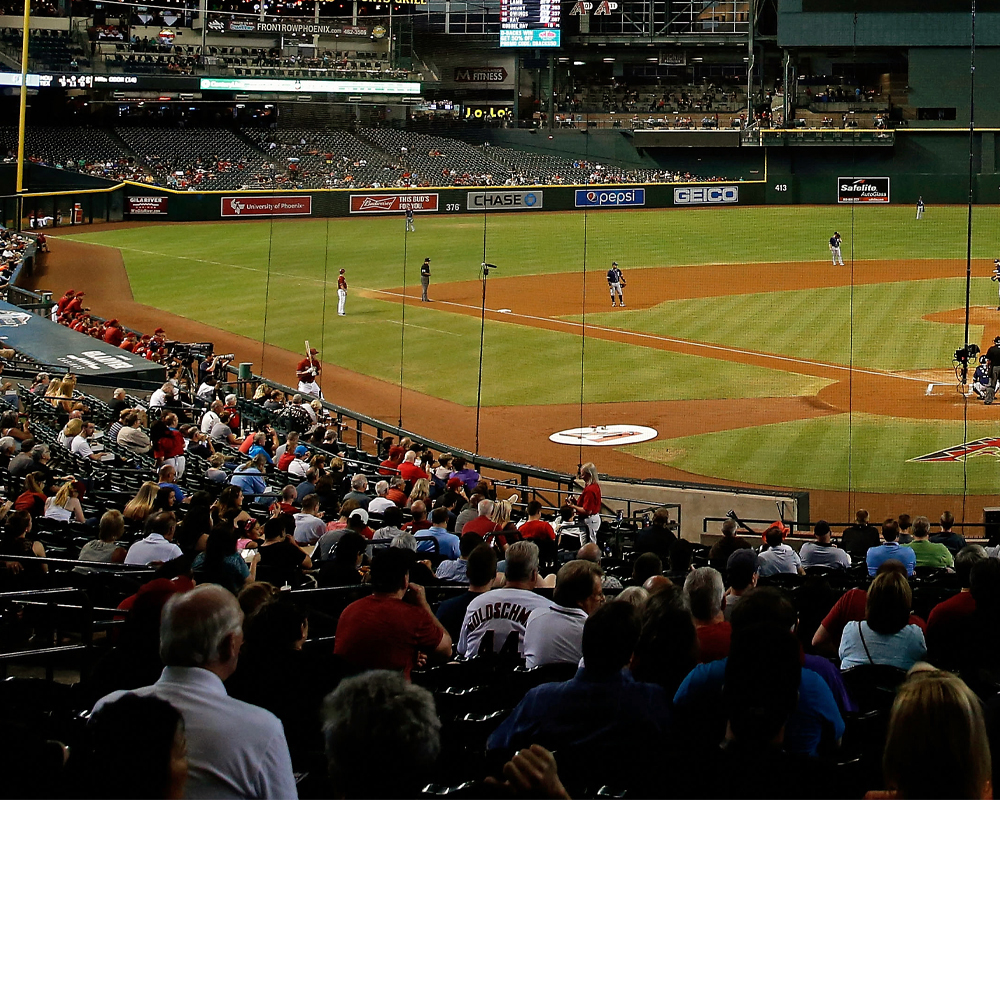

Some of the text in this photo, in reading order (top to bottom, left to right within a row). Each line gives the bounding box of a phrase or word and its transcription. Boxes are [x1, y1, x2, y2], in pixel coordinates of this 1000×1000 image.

[473, 73, 503, 81] FITNESS
[474, 195, 521, 205] CHASE
[600, 190, 635, 204] pepsi
[675, 188, 737, 203] GEICO
